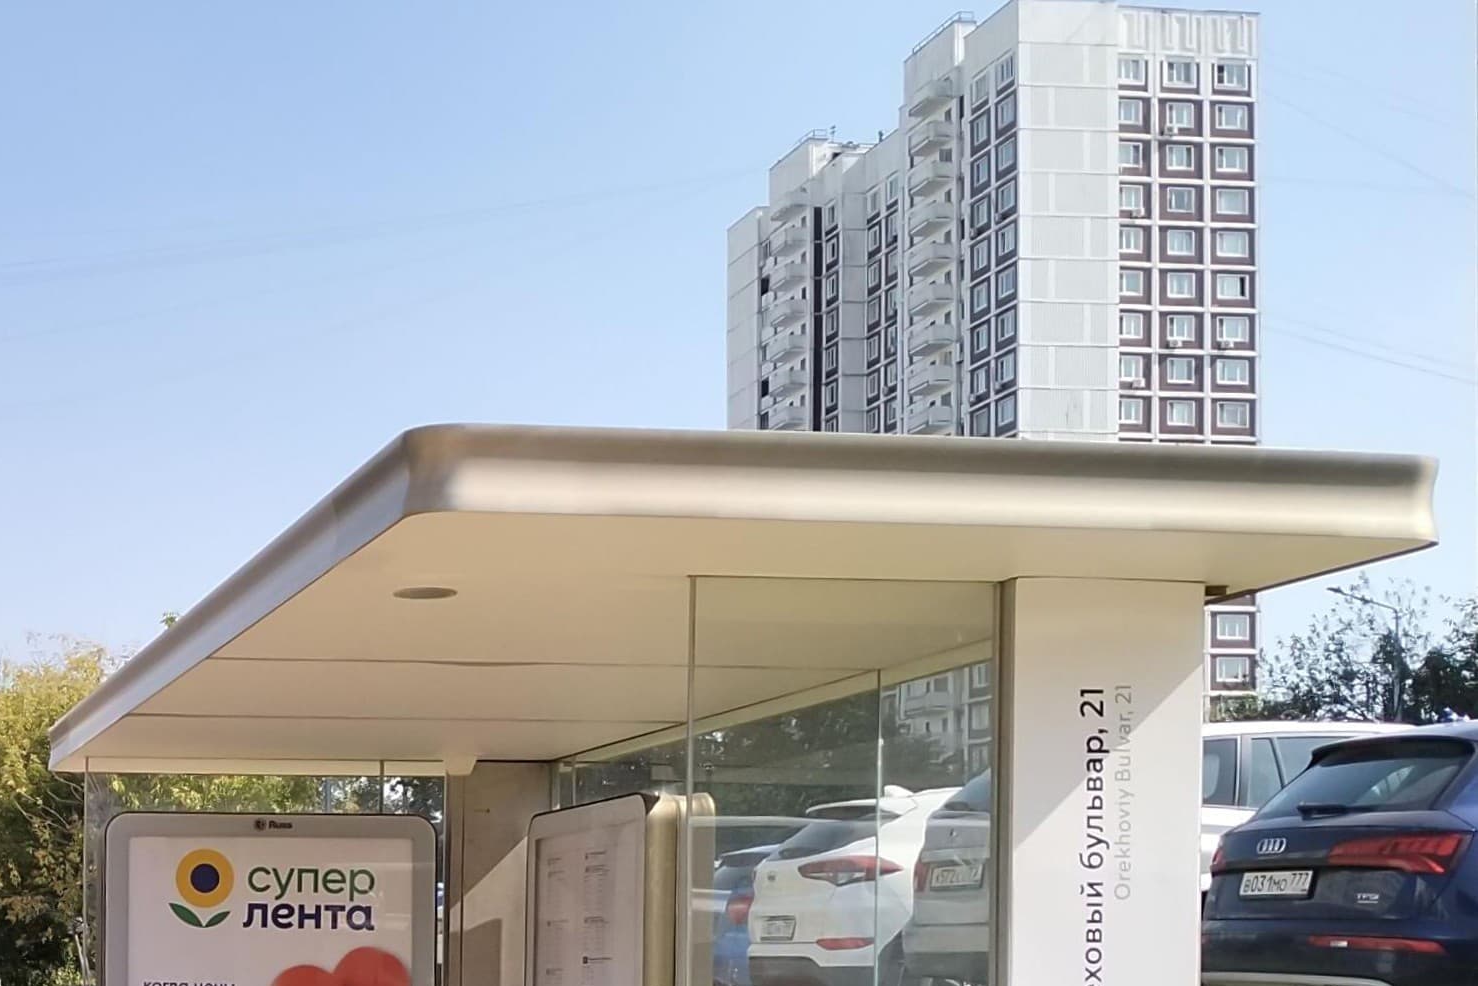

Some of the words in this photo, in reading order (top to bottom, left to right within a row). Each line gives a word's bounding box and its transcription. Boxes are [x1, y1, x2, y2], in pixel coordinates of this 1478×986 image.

[1079, 688, 1105, 718] 21
[1114, 684, 1132, 704] 21
[1114, 710, 1134, 780] Bulvar,
[1079, 727, 1110, 870] бульвар,
[1114, 787, 1135, 900] Orekhoviy
[247, 865, 376, 901] супер
[242, 902, 375, 931] лента
